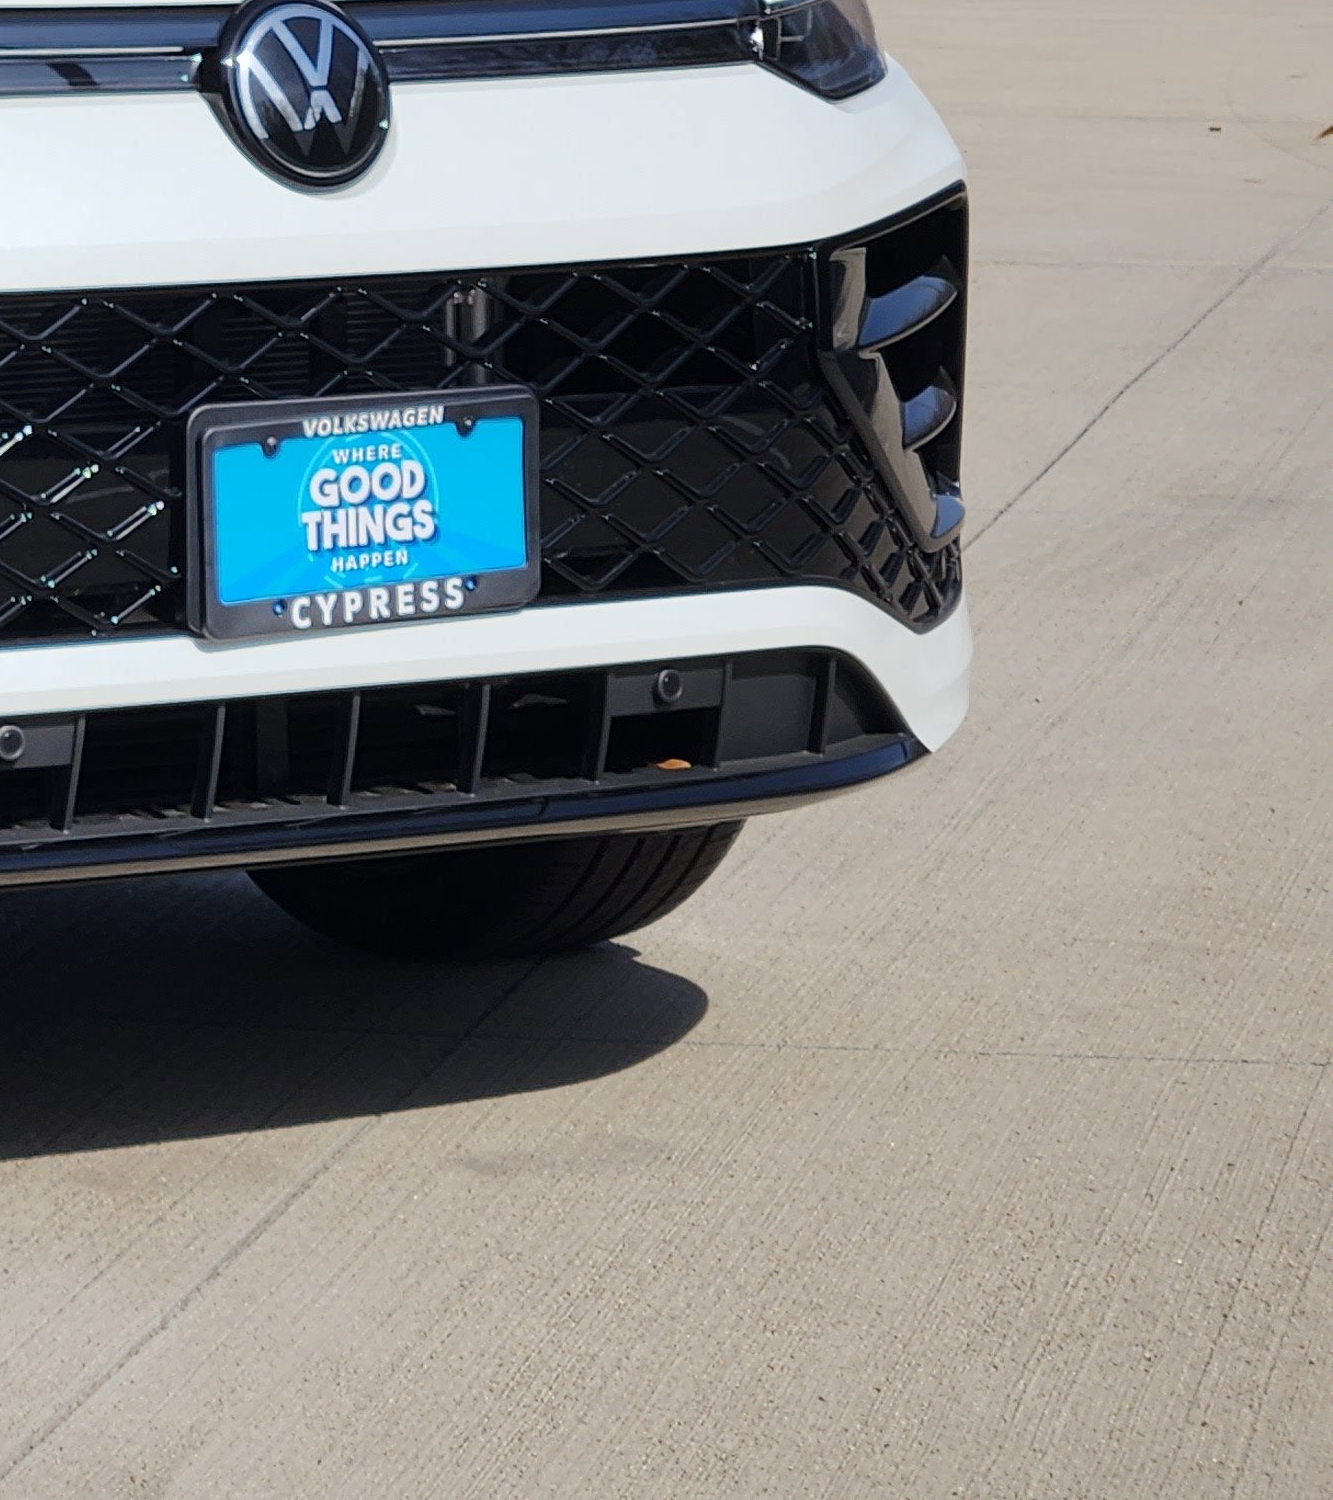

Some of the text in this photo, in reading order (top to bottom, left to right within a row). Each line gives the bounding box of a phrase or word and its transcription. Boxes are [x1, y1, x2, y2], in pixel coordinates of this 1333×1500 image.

[237, 3, 383, 174] VW
[302, 405, 445, 439] VOLKSWAGEN
[332, 443, 403, 466] WHERE
[309, 459, 426, 508] GOOD
[301, 499, 436, 551] THINGS
[331, 548, 409, 572] HAPPEN
[290, 576, 465, 630] CYPRESS
